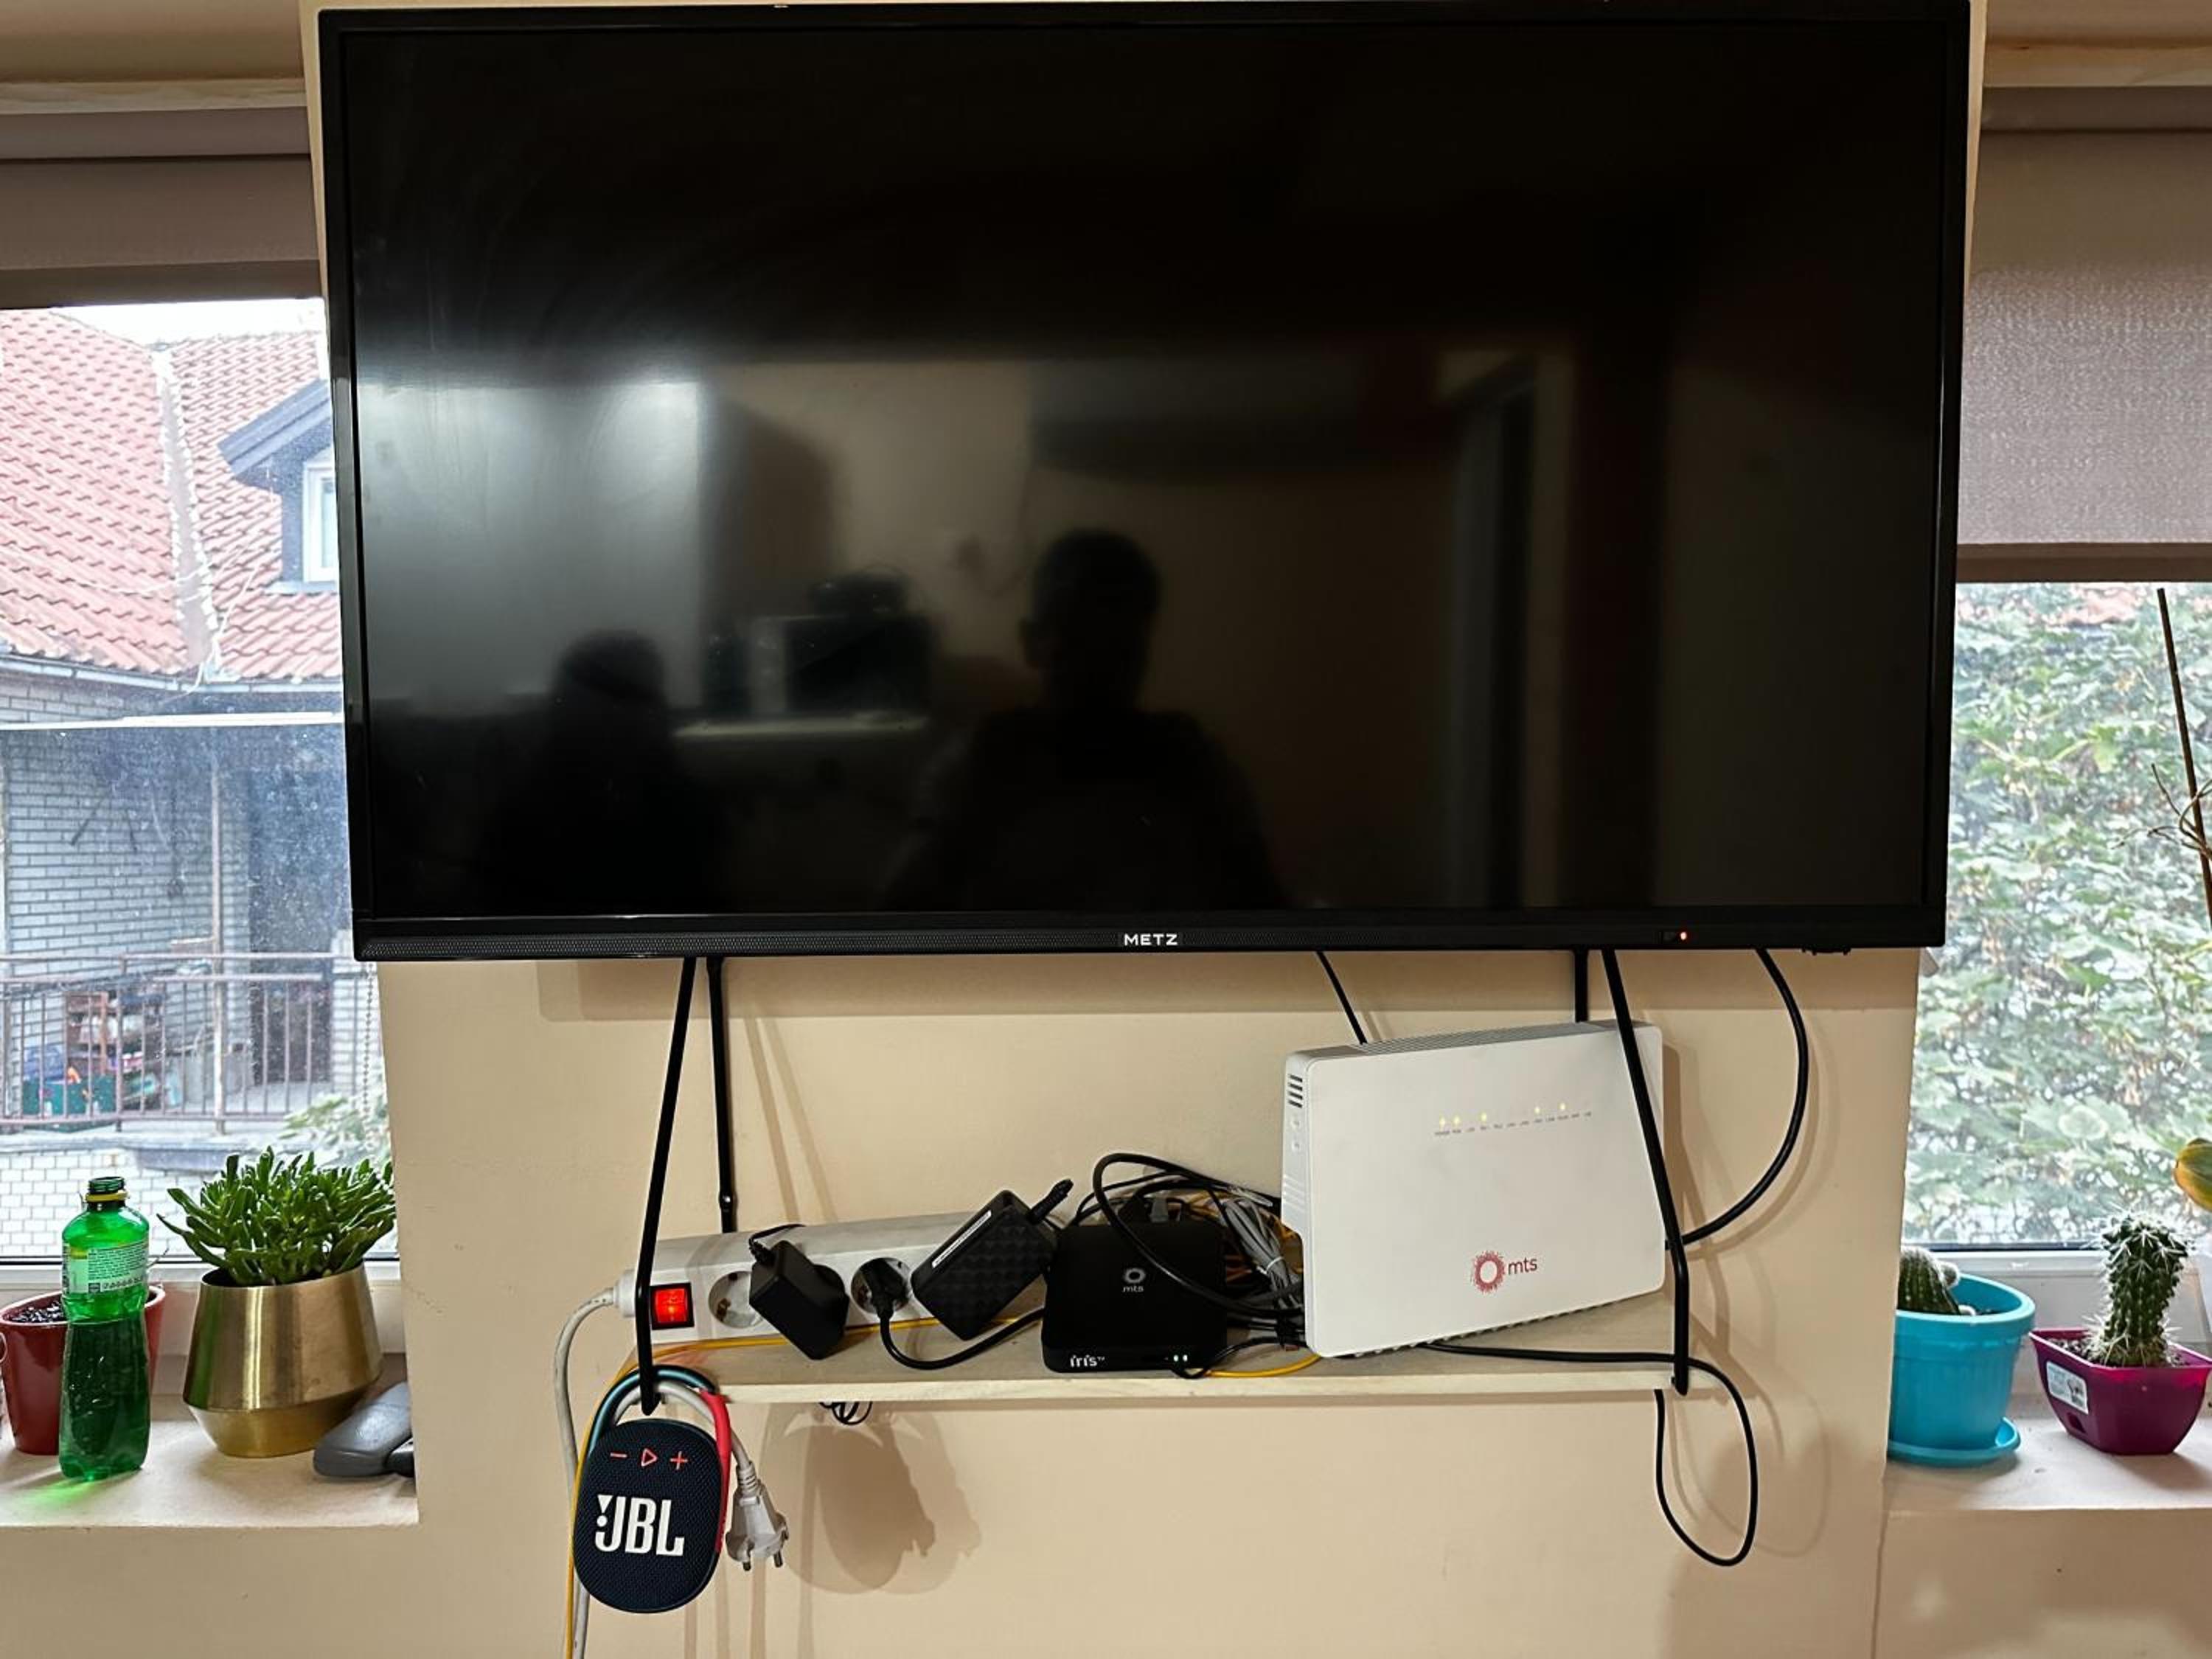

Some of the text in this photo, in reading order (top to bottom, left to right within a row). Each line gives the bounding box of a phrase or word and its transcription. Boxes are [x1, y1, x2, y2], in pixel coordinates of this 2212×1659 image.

[1124, 933, 1178, 946] METZ
[1508, 1256, 1538, 1275] mts
[594, 1494, 685, 1557] JBL
